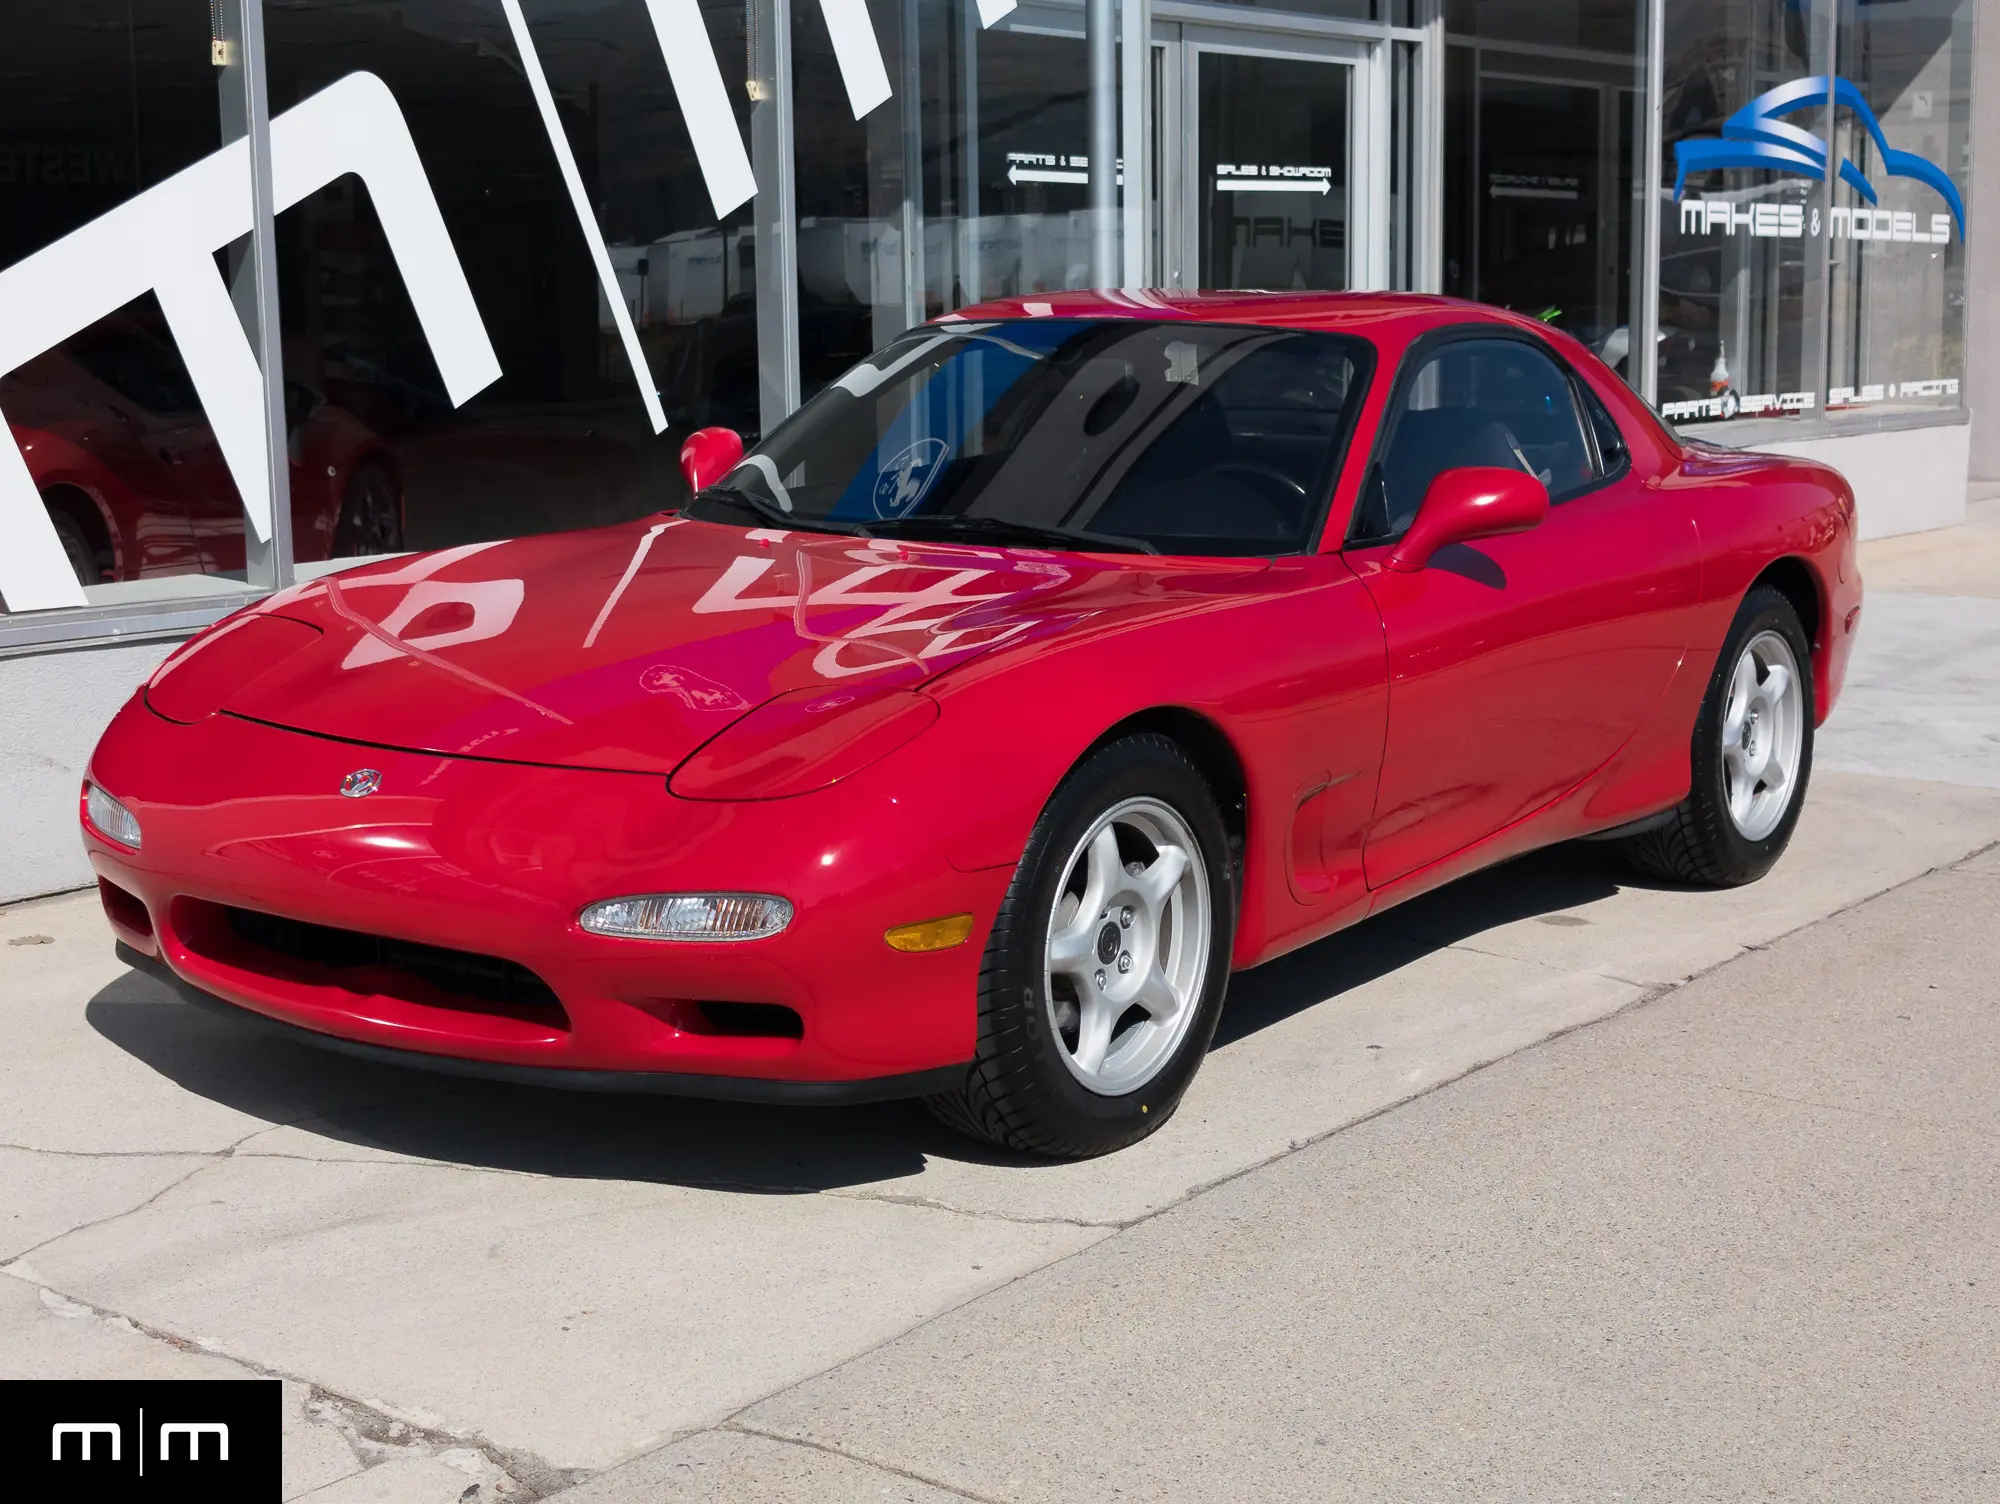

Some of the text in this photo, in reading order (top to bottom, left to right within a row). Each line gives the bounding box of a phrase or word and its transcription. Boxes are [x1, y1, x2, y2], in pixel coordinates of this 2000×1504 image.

[1007, 153, 1055, 165] PARTS
[1216, 164, 1258, 175] SALES
[1269, 166, 1331, 177] SHOWROOM
[1680, 200, 1802, 237] MAKES
[1810, 207, 1821, 237] &
[1829, 207, 1951, 244] MODELS
[1829, 378, 1959, 404] SALES RACING
[1662, 392, 1815, 420] PARTS SERVICE
